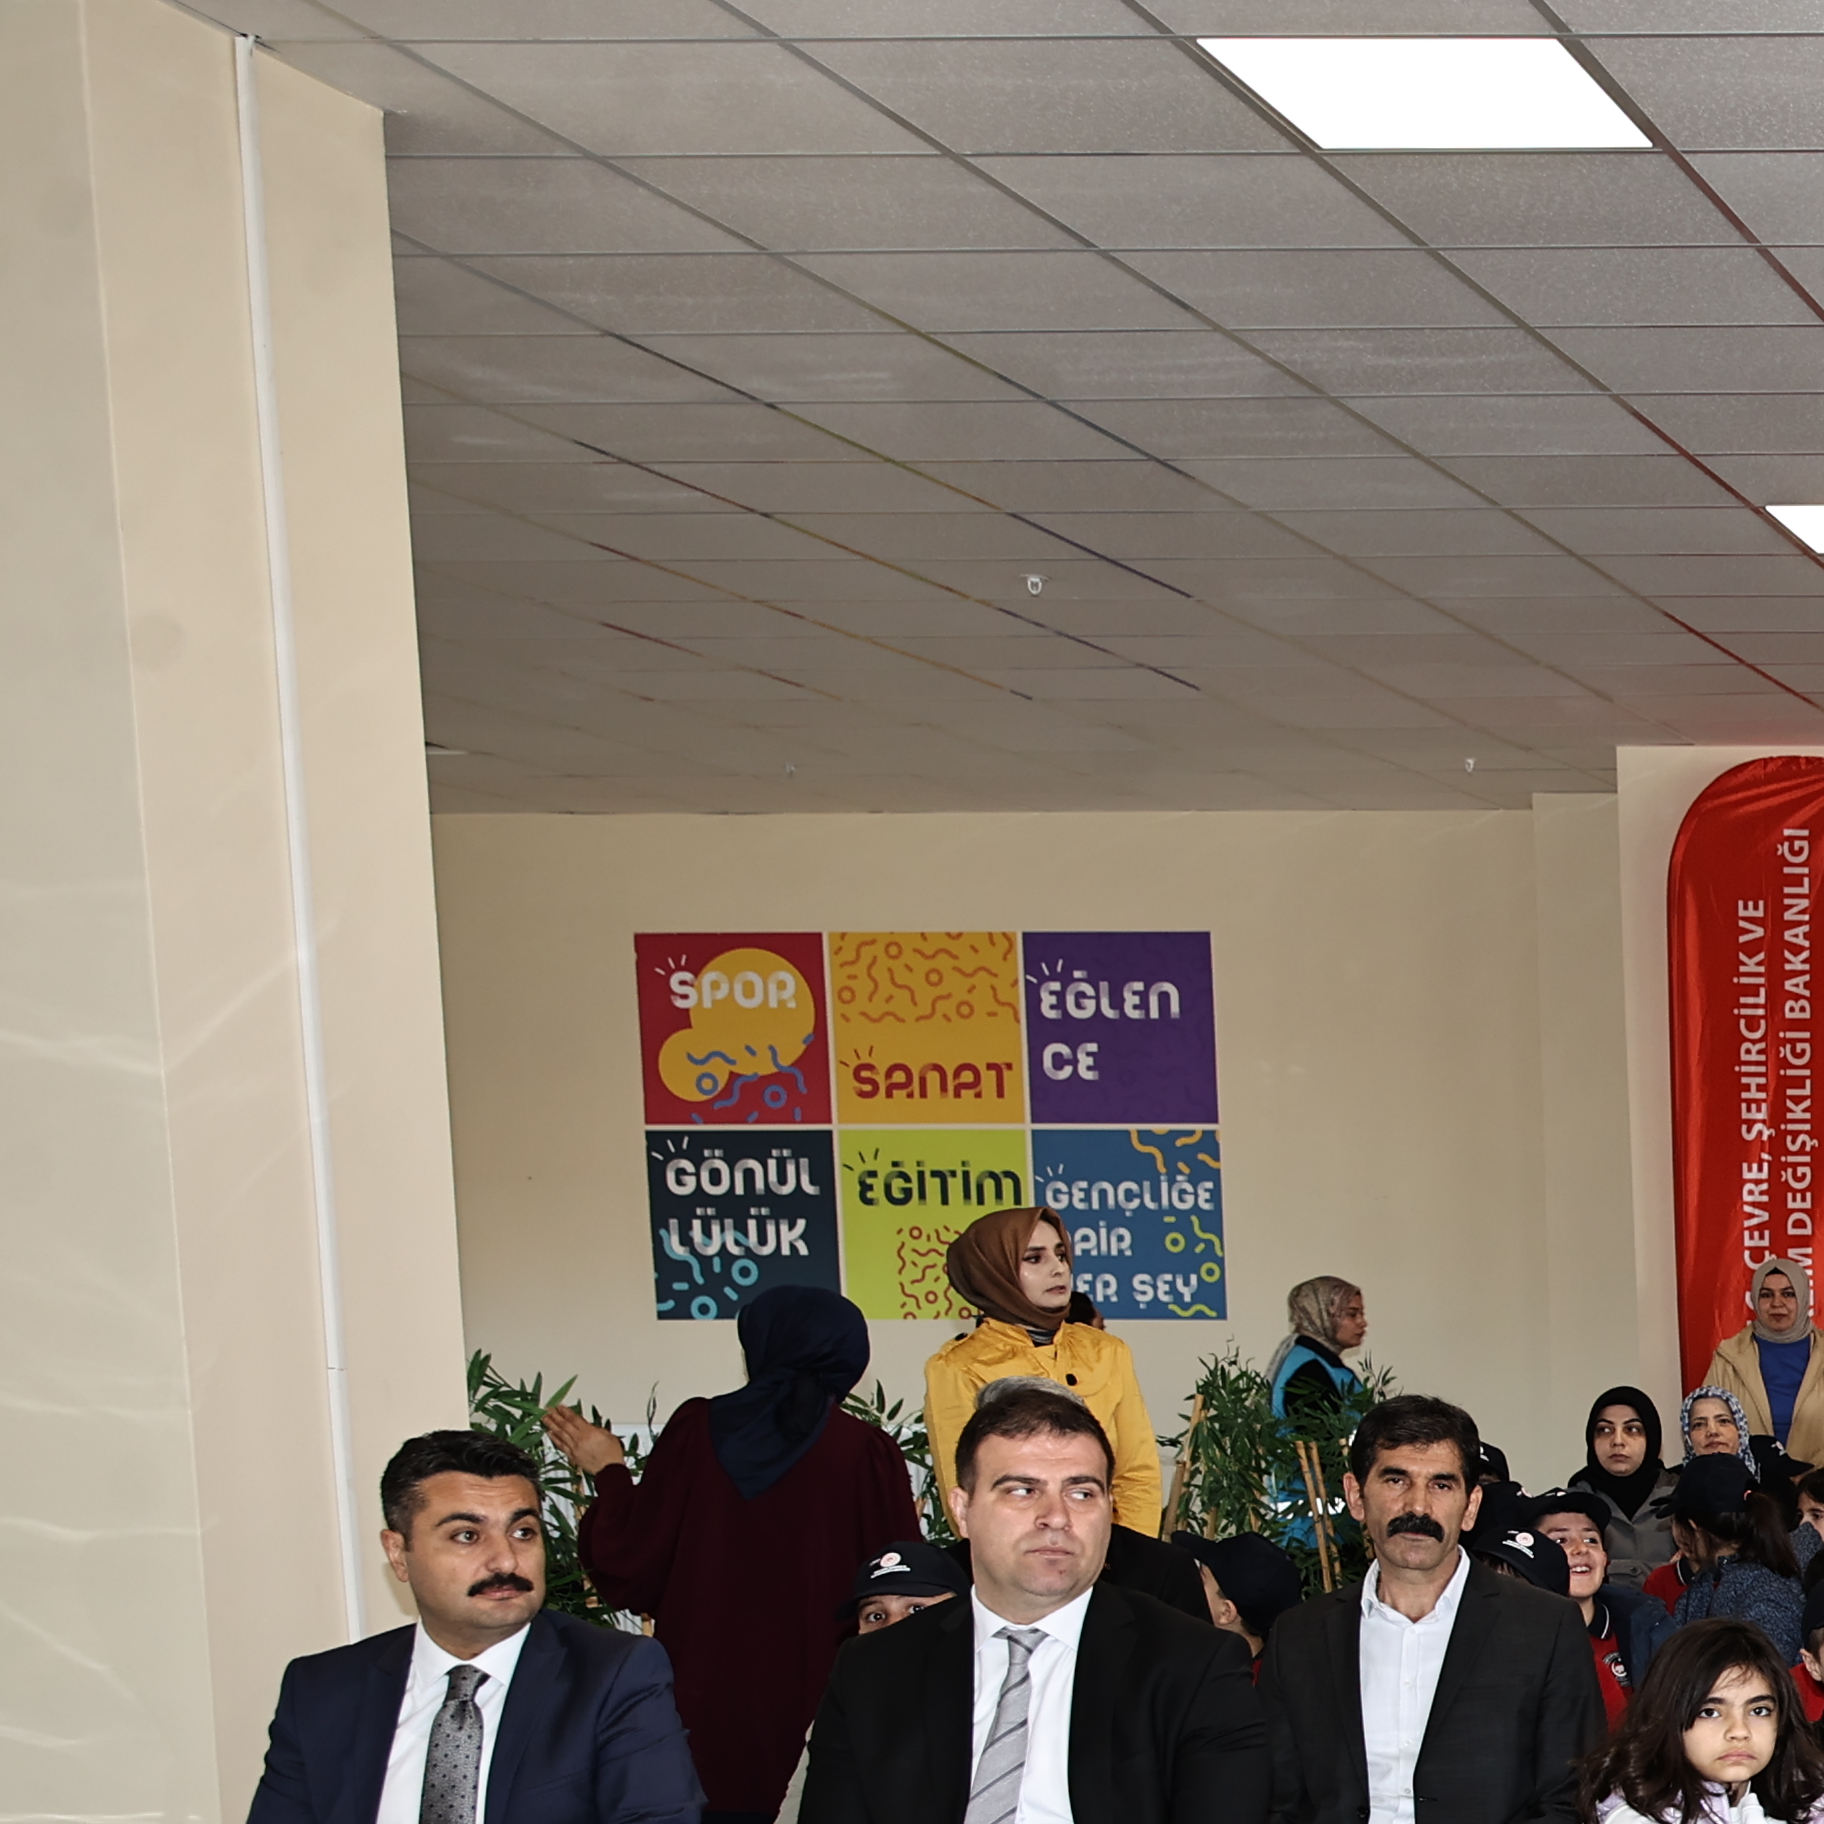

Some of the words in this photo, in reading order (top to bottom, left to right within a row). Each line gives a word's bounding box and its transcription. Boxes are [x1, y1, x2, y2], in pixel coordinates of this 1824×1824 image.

[1737, 899, 1766, 943] VE
[1777, 828, 1811, 1019] BAKANLIĞI
[669, 970, 797, 1009] SPOR
[1040, 970, 1180, 1020] EĞLEN
[1042, 1042, 1099, 1081] CE
[1733, 951, 1775, 1142] ŞEHİRCİLİK
[853, 1062, 1013, 1099] SANAT
[1778, 1030, 1819, 1236] DEĞİŞİKLİĞİ
[665, 1148, 821, 1196] GÖNÜL
[858, 1160, 1022, 1206] EĞİTİM
[1045, 1174, 1215, 1217] GENÇLİĞE
[668, 1207, 809, 1256] LÜLÜK
[1067, 1220, 1133, 1256] AİR
[1071, 1273, 1119, 1302] ER
[1132, 1273, 1198, 1310] ŞEY
